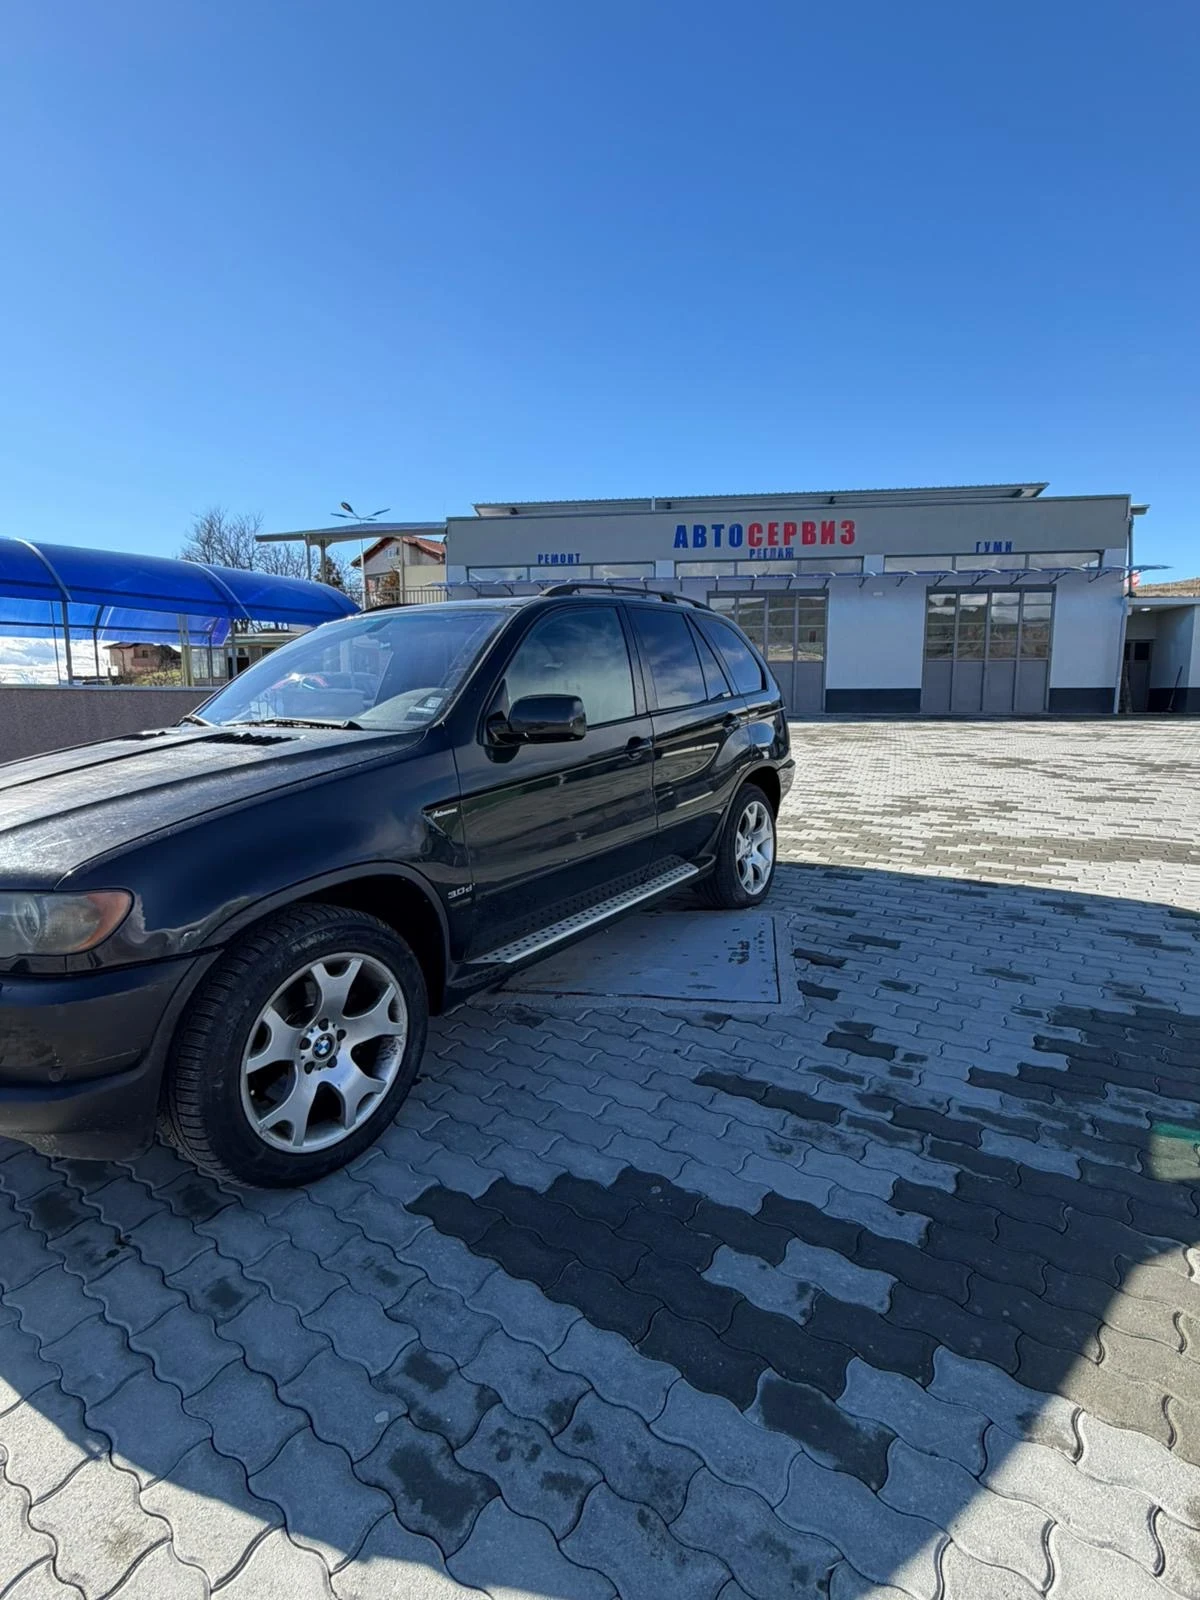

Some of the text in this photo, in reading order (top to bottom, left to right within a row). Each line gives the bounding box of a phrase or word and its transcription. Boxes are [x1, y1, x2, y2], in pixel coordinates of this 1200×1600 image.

[673, 520, 856, 549] АВТОСЕРВИЗ
[976, 541, 1013, 553] ГУМИ
[537, 552, 581, 565] РЕМОНТ
